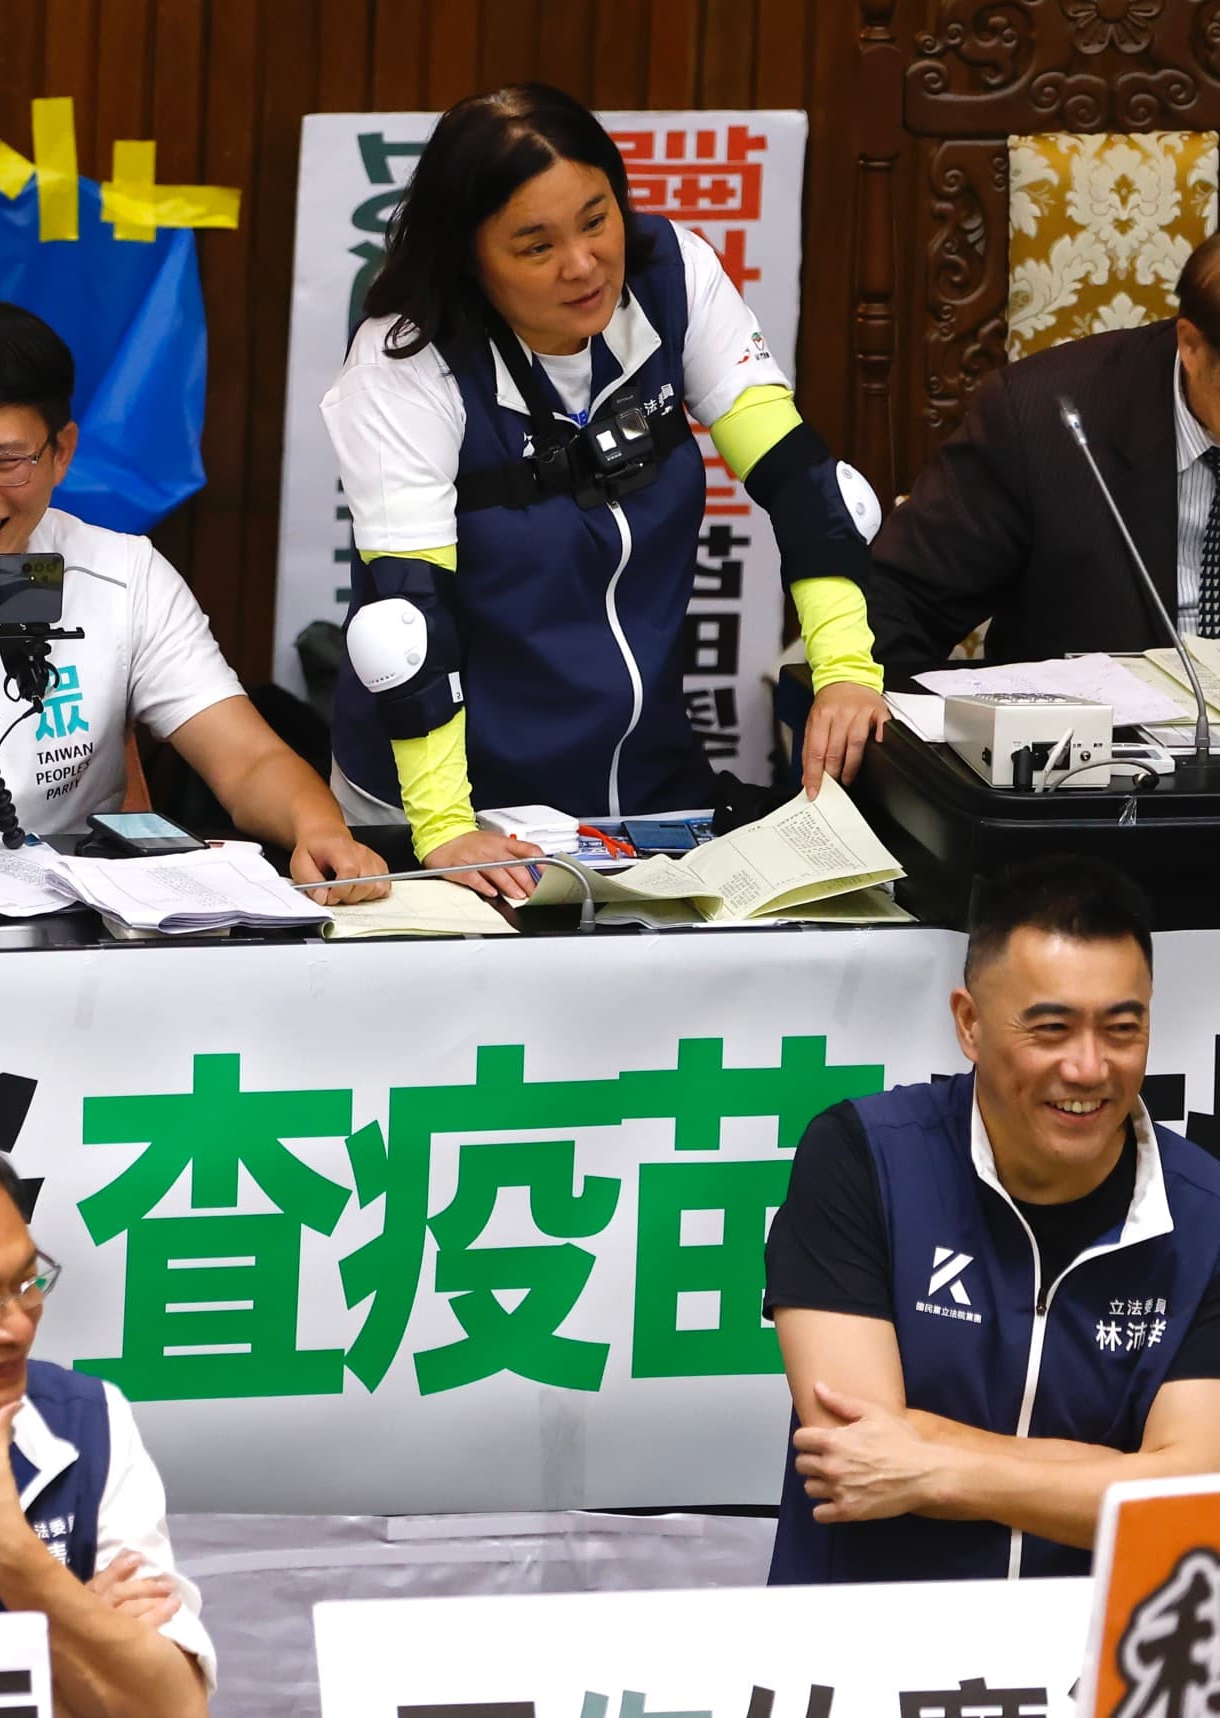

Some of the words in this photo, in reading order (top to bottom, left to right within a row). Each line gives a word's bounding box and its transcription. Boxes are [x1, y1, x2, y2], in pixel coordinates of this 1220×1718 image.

[36, 742, 93, 765] TAIWAN
[72, 1035, 885, 1403] 查疫苗
[1108, 1298, 1167, 1316] 立法委員
